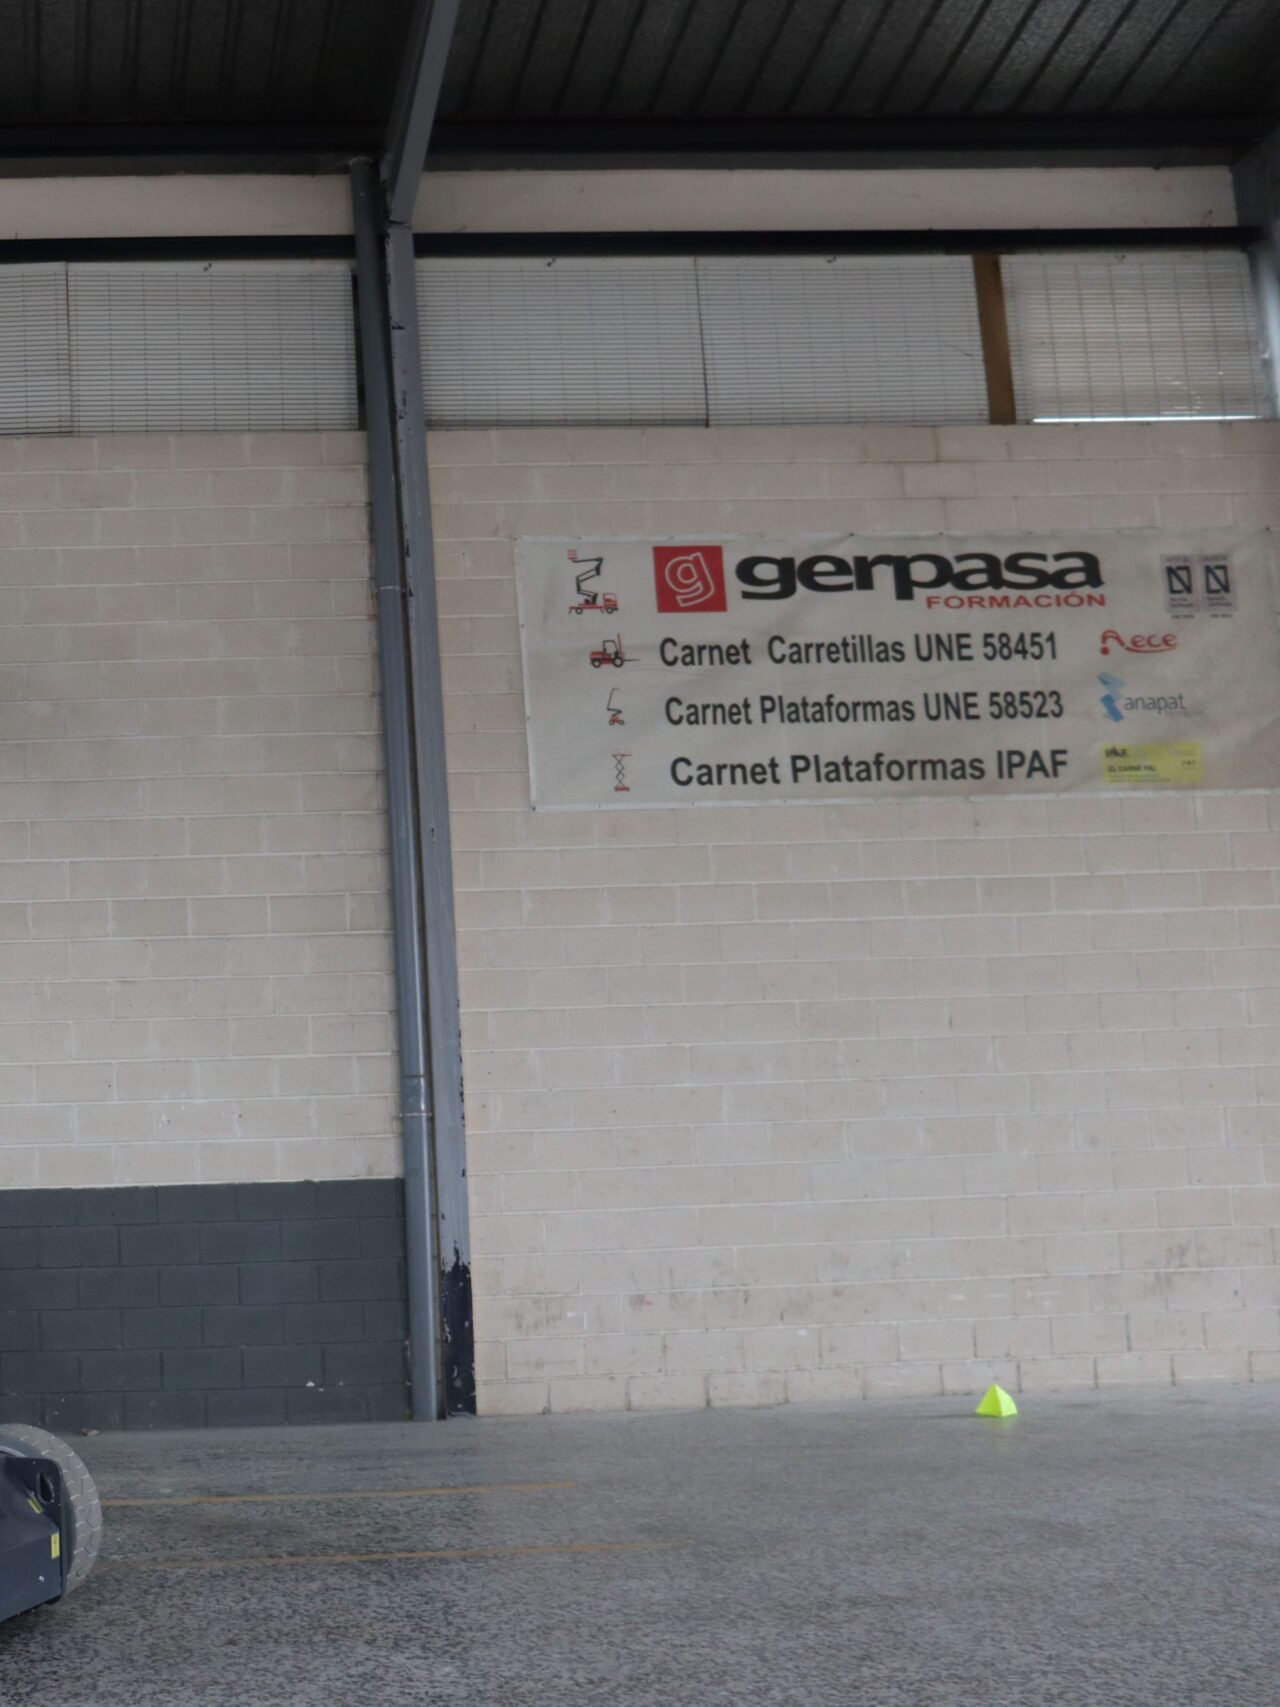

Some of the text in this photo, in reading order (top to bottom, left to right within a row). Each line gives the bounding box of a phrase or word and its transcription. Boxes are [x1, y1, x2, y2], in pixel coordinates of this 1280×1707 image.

[735, 551, 1105, 600] gerpasa
[925, 591, 1106, 609] FORMACIÓN
[659, 631, 1057, 666] Carnet Carretillas UNE 58451
[665, 691, 1064, 725] Carnet Plataformas UNE 58523
[1124, 692, 1187, 714] anapat
[670, 749, 1068, 786] Carnet Plataformas IPAF
